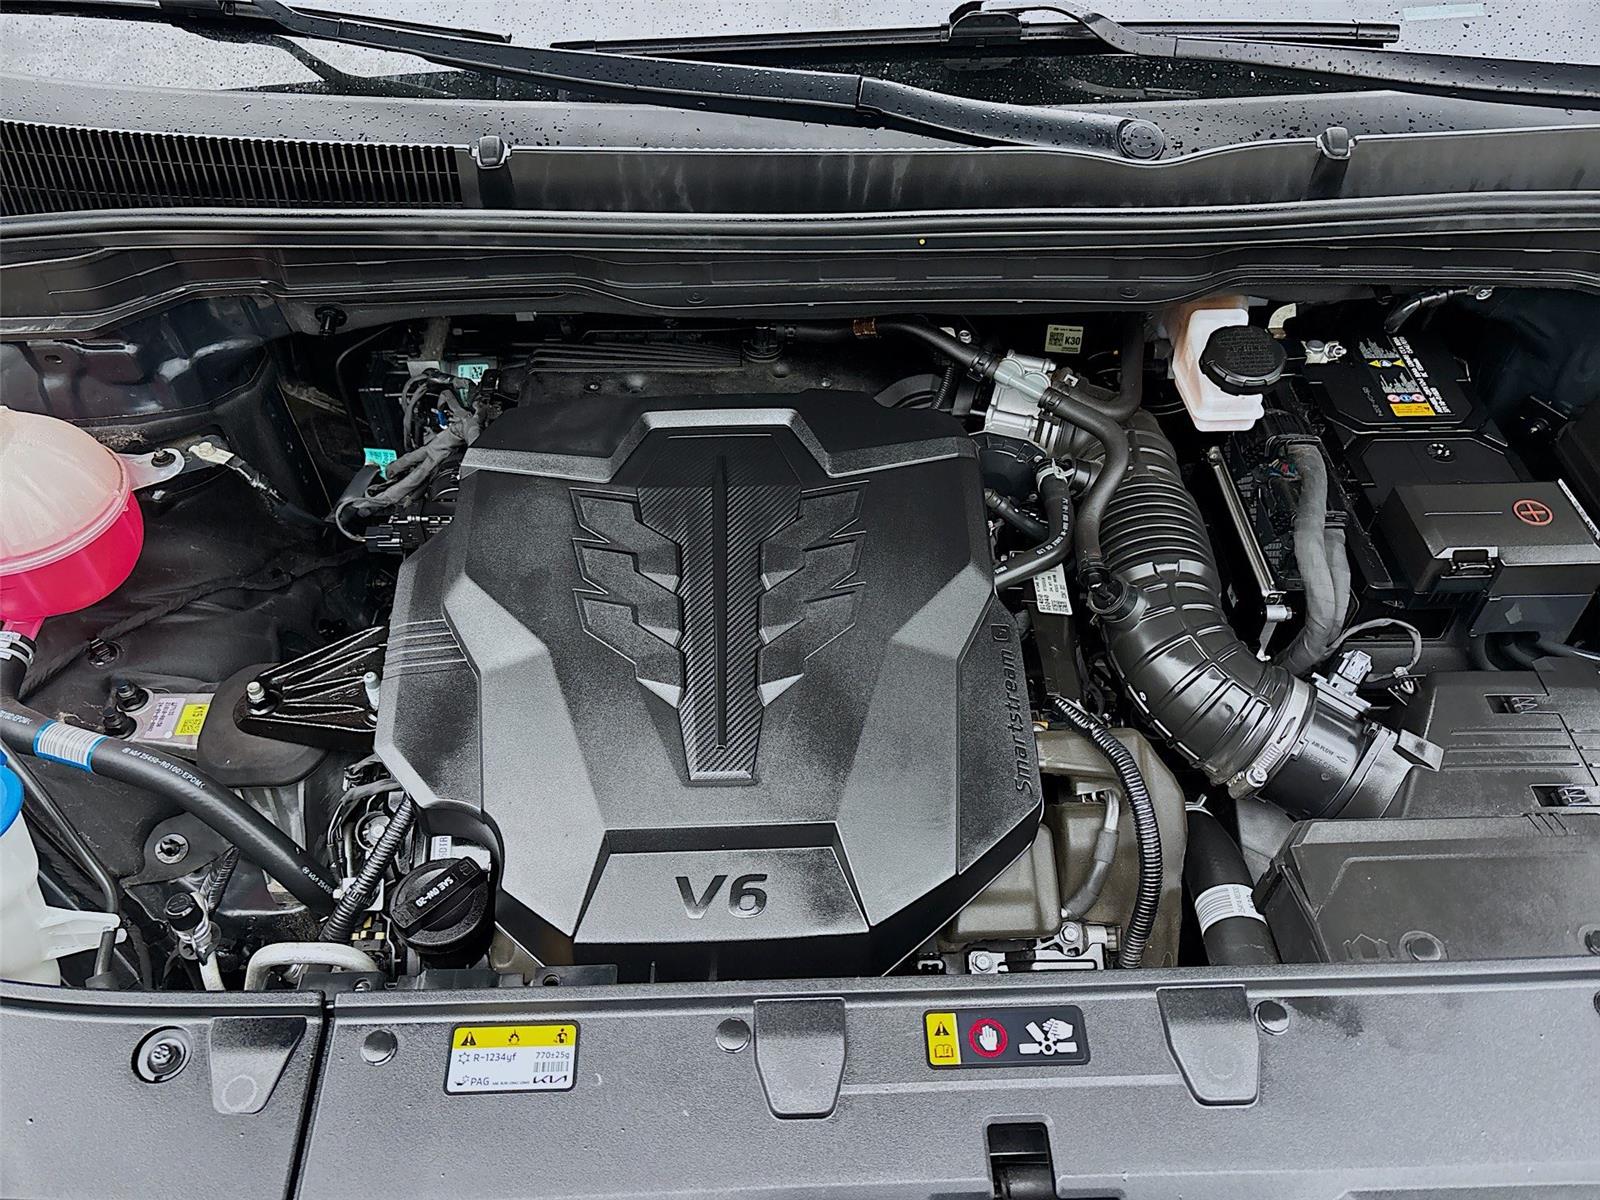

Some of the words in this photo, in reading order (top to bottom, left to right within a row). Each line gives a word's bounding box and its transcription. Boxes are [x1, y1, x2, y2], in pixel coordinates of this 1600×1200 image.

[1065, 336, 1081, 346] K30
[1001, 649, 1033, 796] Smartstream
[436, 876, 454, 891] SAE
[675, 873, 768, 919] V6
[473, 1052, 518, 1063] R-1234yf
[470, 1077, 490, 1086] PAG
